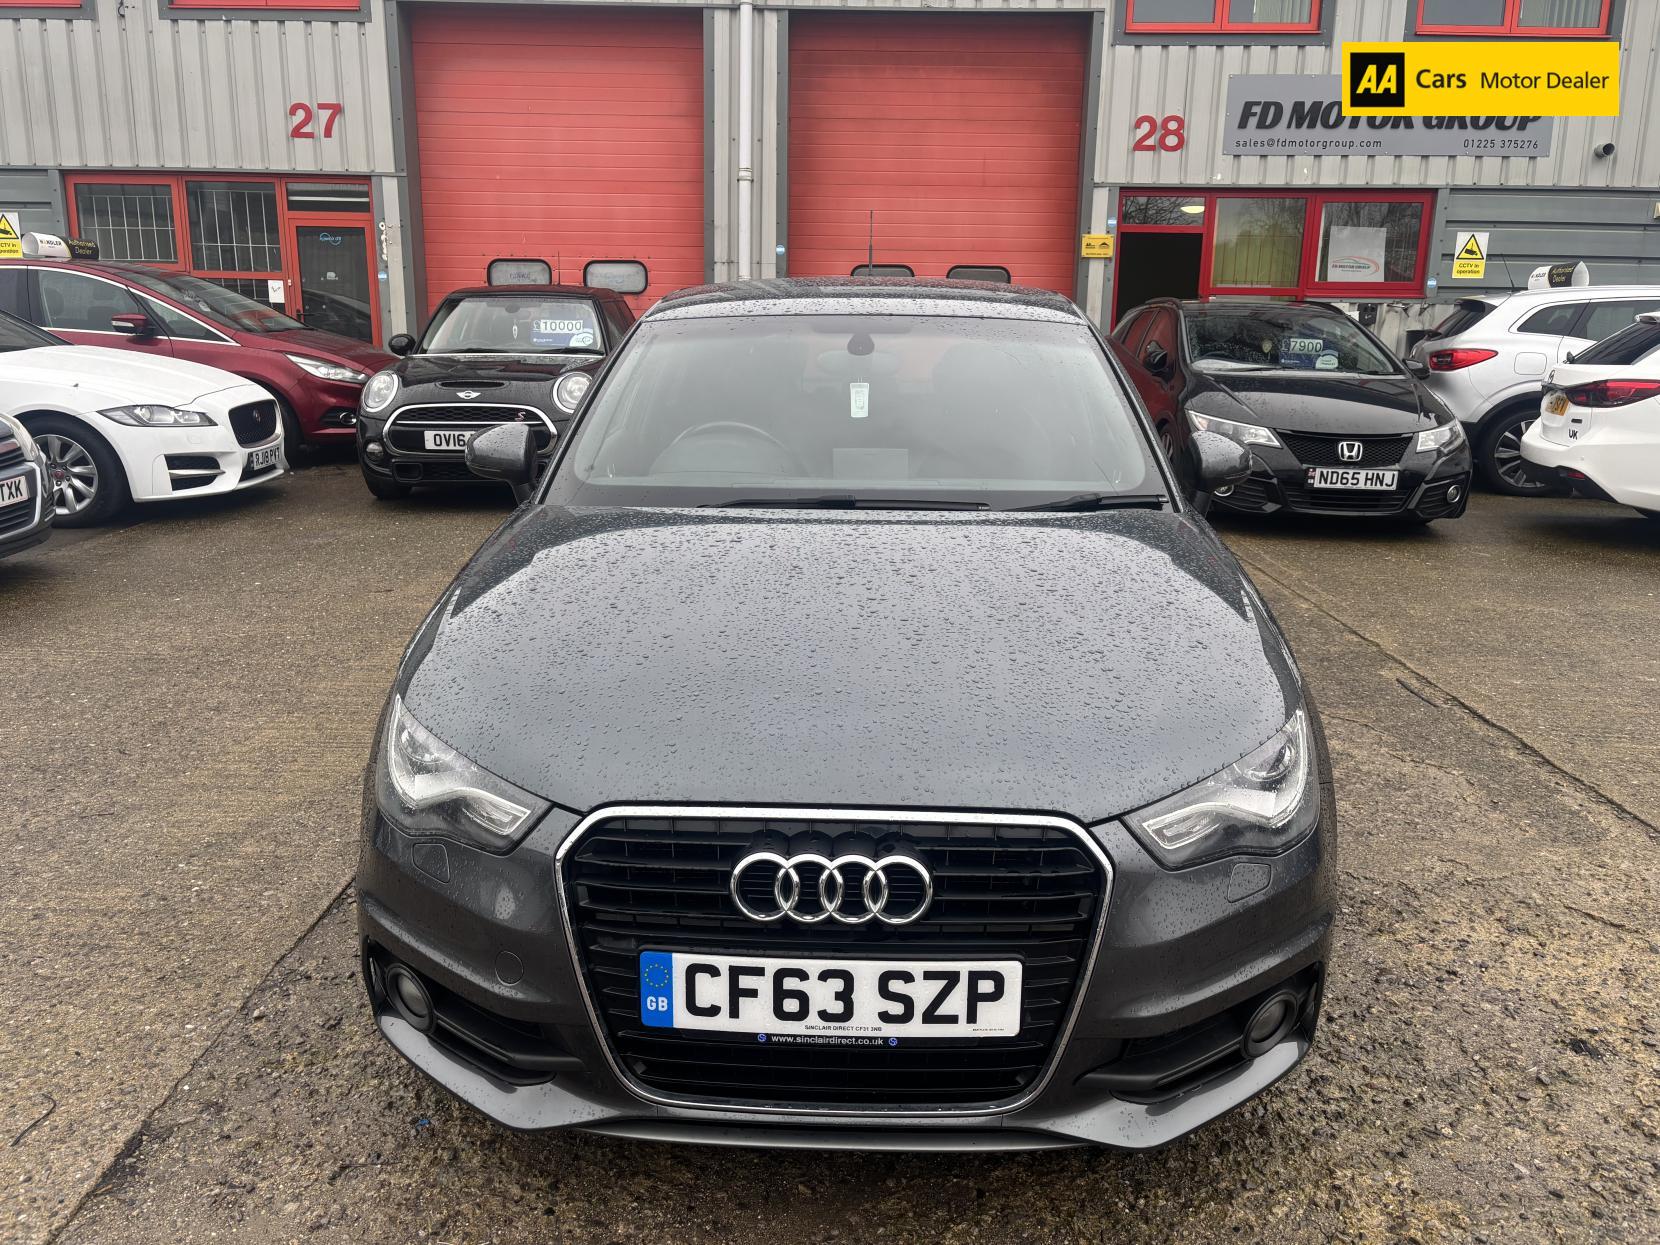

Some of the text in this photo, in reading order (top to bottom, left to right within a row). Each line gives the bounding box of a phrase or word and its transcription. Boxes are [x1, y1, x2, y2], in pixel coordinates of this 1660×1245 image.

[289, 102, 342, 139] 27
[1237, 100, 1284, 130] FD
[1132, 114, 1185, 152] 28
[1235, 138, 1382, 150] sales@fdmotorgroup.com
[1463, 139, 1539, 150] 01225 375276
[433, 433, 466, 448] OV16
[1568, 428, 1578, 440] UK
[1318, 470, 1396, 488] ND65 HNJ
[685, 962, 1006, 1025] CF63 SZP
[646, 996, 668, 1012] GB
[771, 1035, 884, 1046] www.sinclairdirect.co.uk
